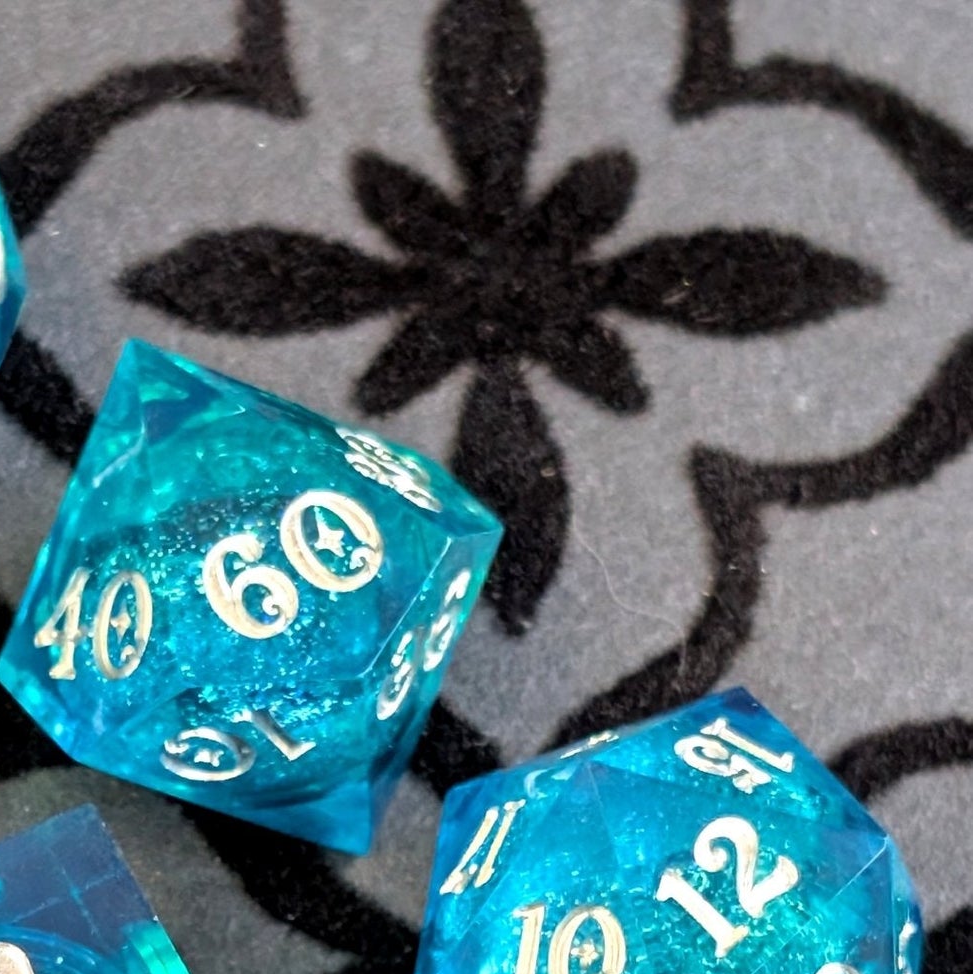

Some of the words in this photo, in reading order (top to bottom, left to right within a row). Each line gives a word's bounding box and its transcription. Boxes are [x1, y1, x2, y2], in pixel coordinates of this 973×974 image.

[34, 566, 154, 681] 40
[201, 488, 384, 640] 60
[159, 707, 317, 783] 10
[655, 814, 801, 959] 12
